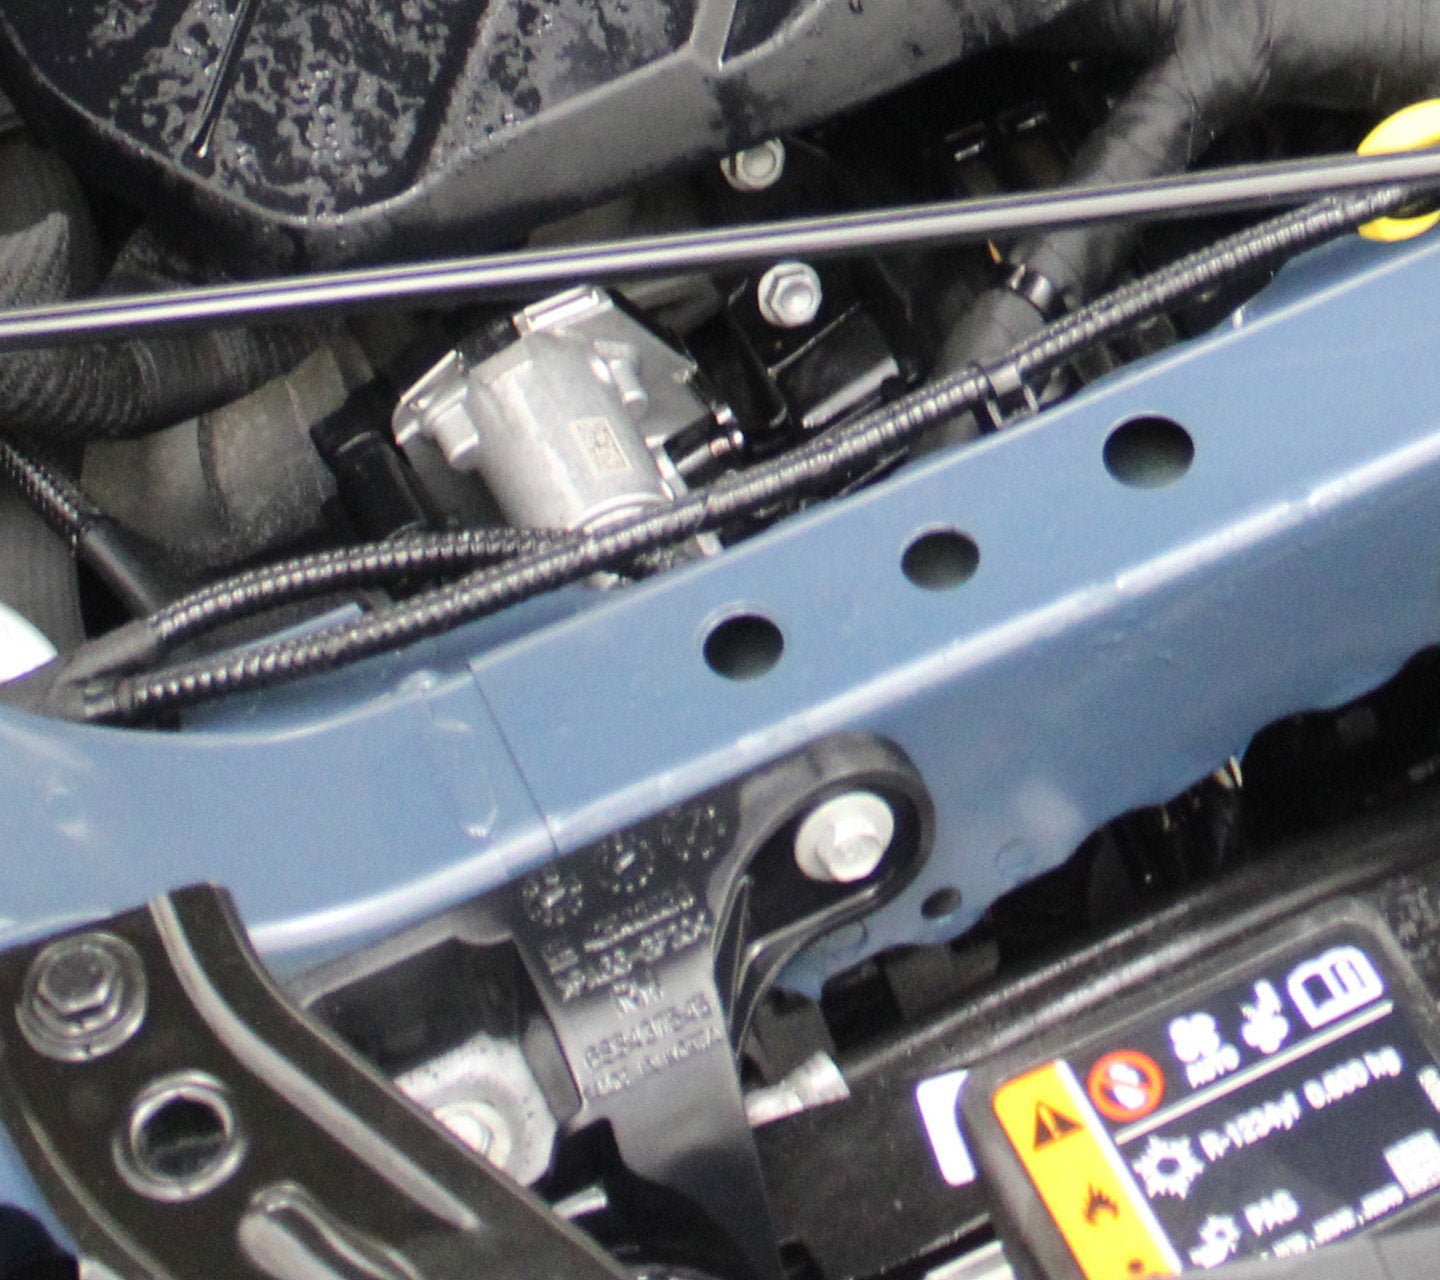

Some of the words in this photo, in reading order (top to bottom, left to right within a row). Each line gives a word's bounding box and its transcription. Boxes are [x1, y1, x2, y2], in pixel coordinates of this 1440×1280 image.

[1186, 1044, 1241, 1089] AUTO
[1199, 1091, 1301, 1161] R-1234yf
[1244, 1188, 1300, 1236] PAG
